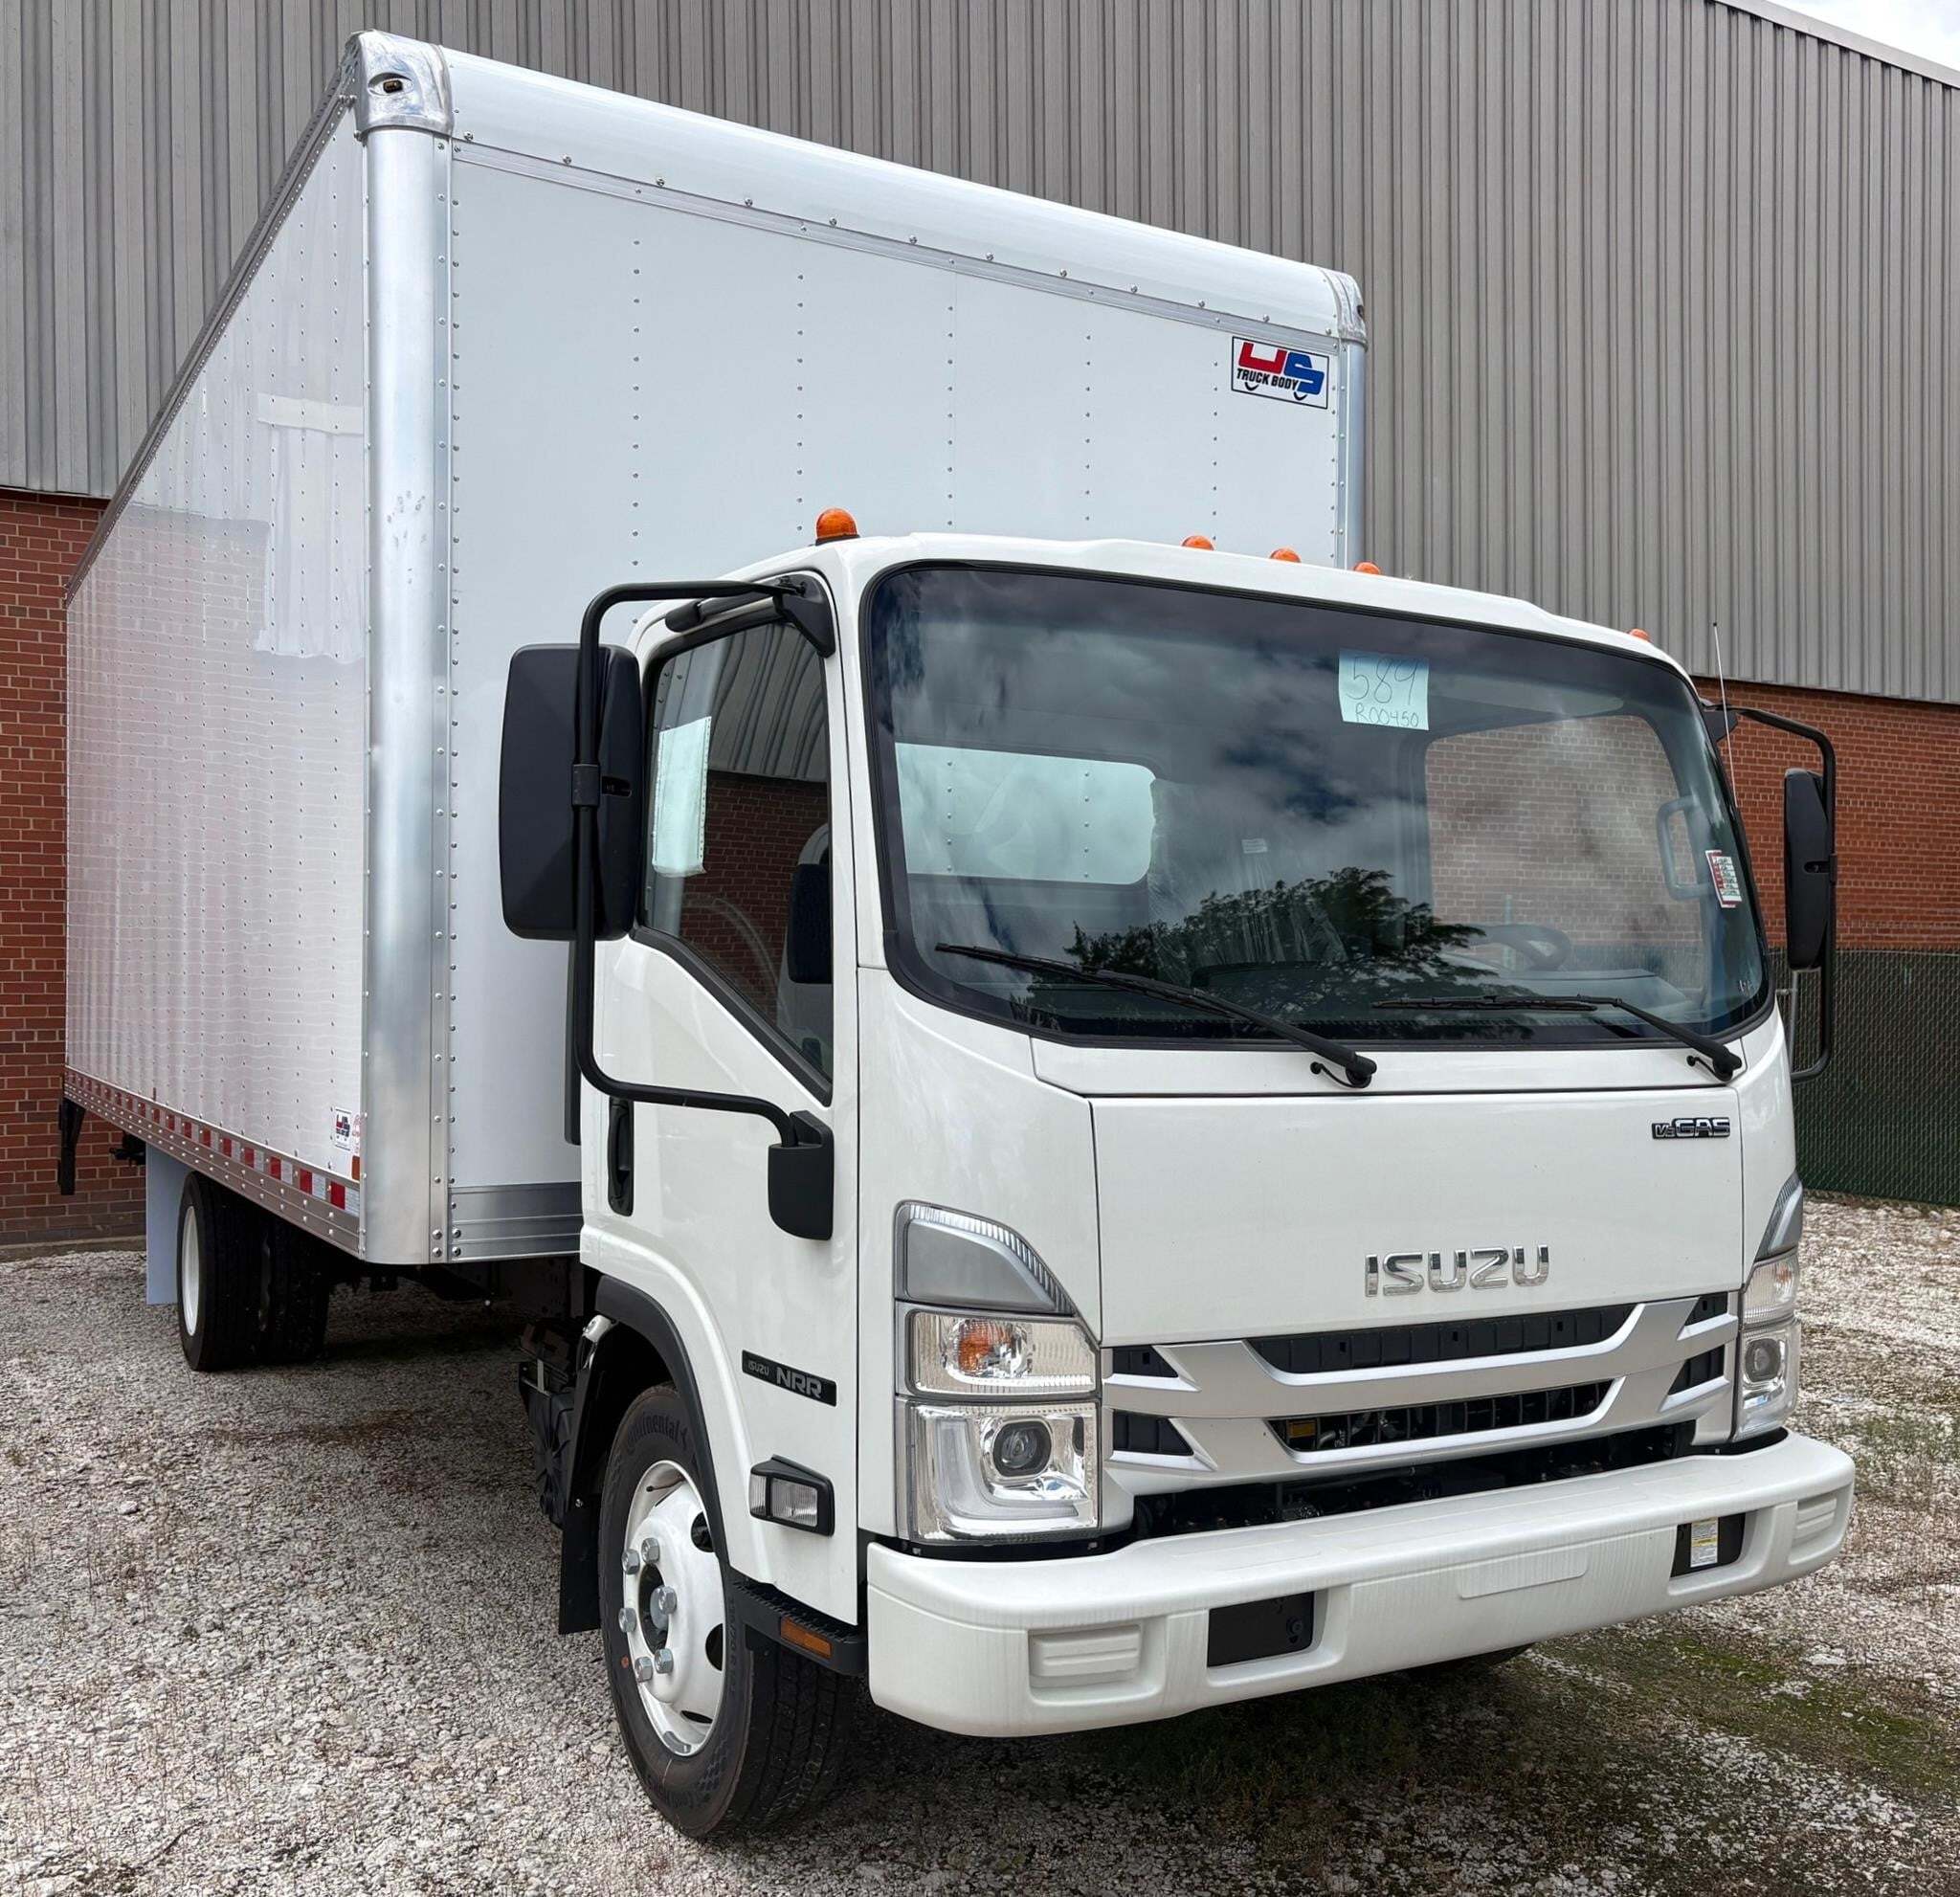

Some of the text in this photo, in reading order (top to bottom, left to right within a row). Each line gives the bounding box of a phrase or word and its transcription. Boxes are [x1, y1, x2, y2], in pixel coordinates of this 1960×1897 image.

[1236, 368, 1299, 391] TRUCK BODY
[1238, 342, 1325, 395] US
[1346, 656, 1418, 705] 589
[1355, 703, 1419, 727] R00450
[1676, 1118, 1730, 1137] GAS
[1365, 1245, 1549, 1297] ISUZU
[747, 1359, 822, 1398] ISUZU NRR
